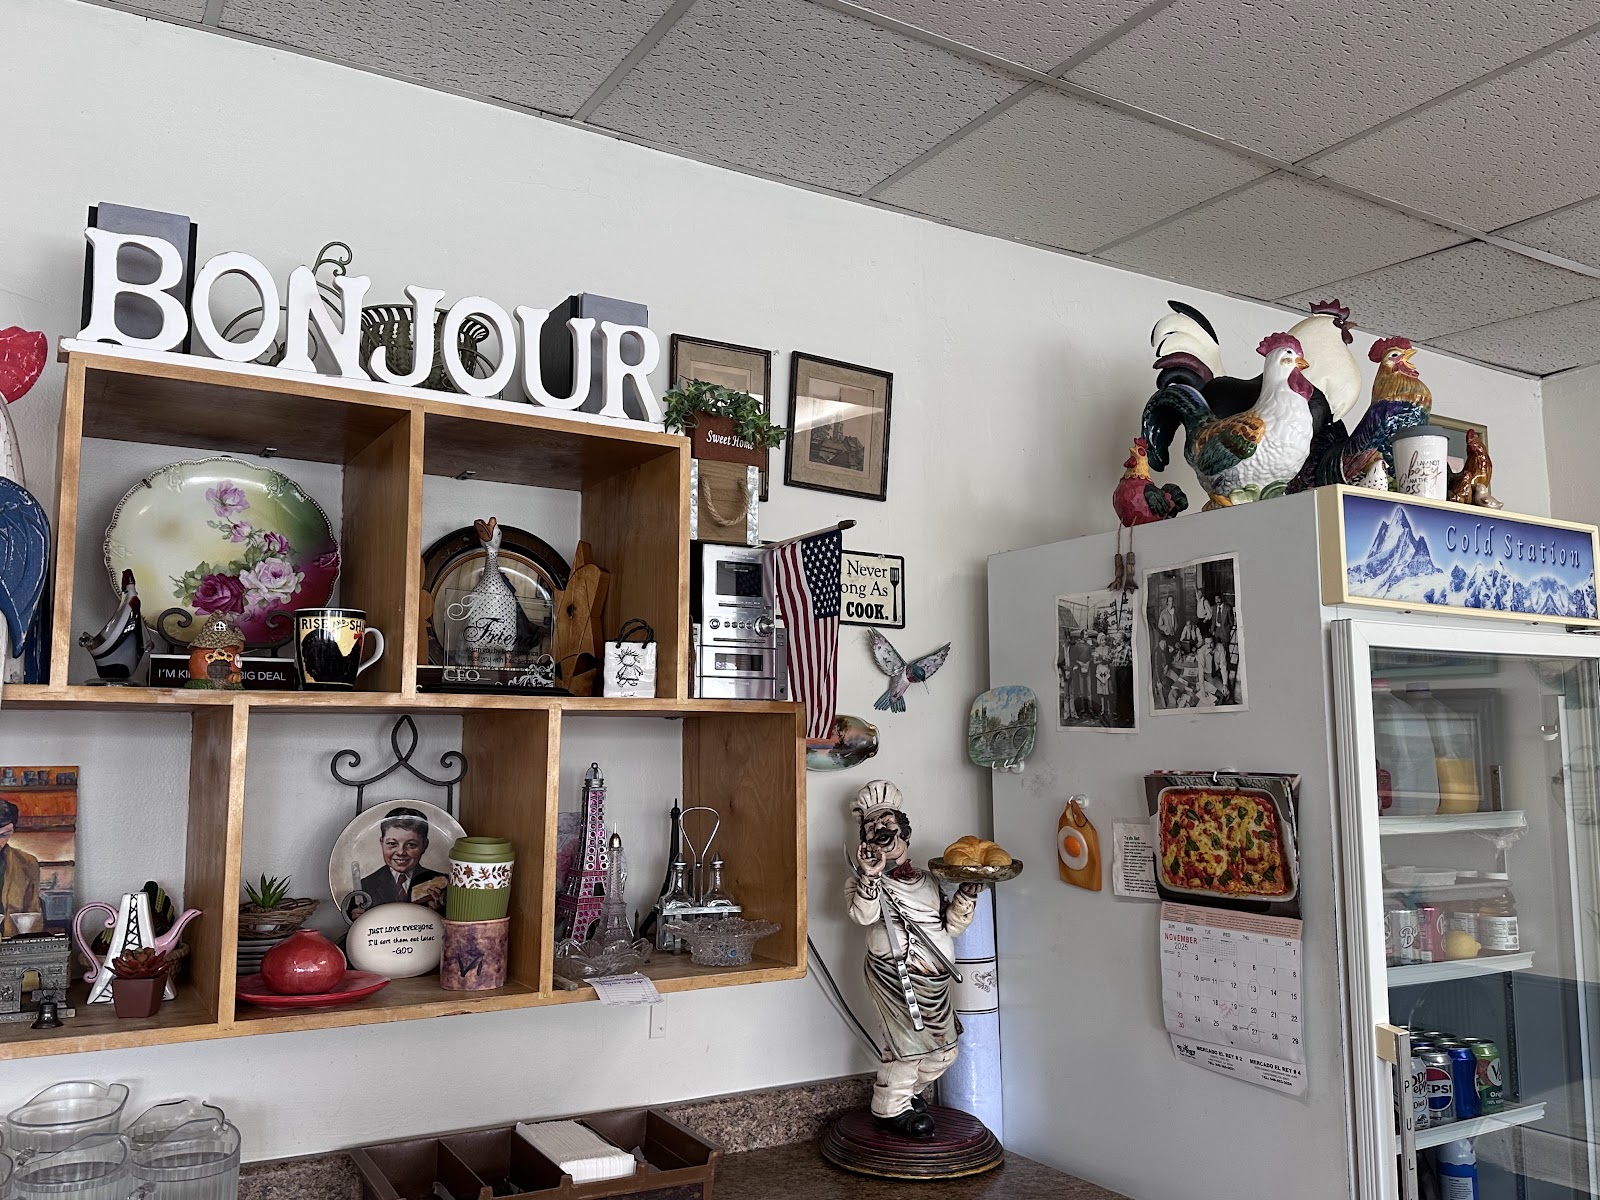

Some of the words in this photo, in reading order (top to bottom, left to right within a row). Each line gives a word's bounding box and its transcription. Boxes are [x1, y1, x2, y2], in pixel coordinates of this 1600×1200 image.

[76, 227, 663, 423] BONJOUR
[706, 430, 731, 446] Sweet
[1445, 523, 1495, 556] Cold
[1504, 533, 1581, 567] Station
[846, 559, 888, 579] Never
[841, 583, 867, 599] ong
[870, 580, 889, 597] As
[846, 601, 889, 621] COOK.
[301, 618, 328, 630] RISE
[158, 669, 176, 679] I'M
[257, 671, 287, 681] DEAL
[367, 926, 384, 936] JUST
[385, 925, 401, 933] LOVE
[1164, 932, 1198, 945] NOVEMBER
[1174, 942, 1188, 951] 2025
[1196, 1045, 1218, 1055] MERCADO
[1249, 1058, 1274, 1069] MERCADO
